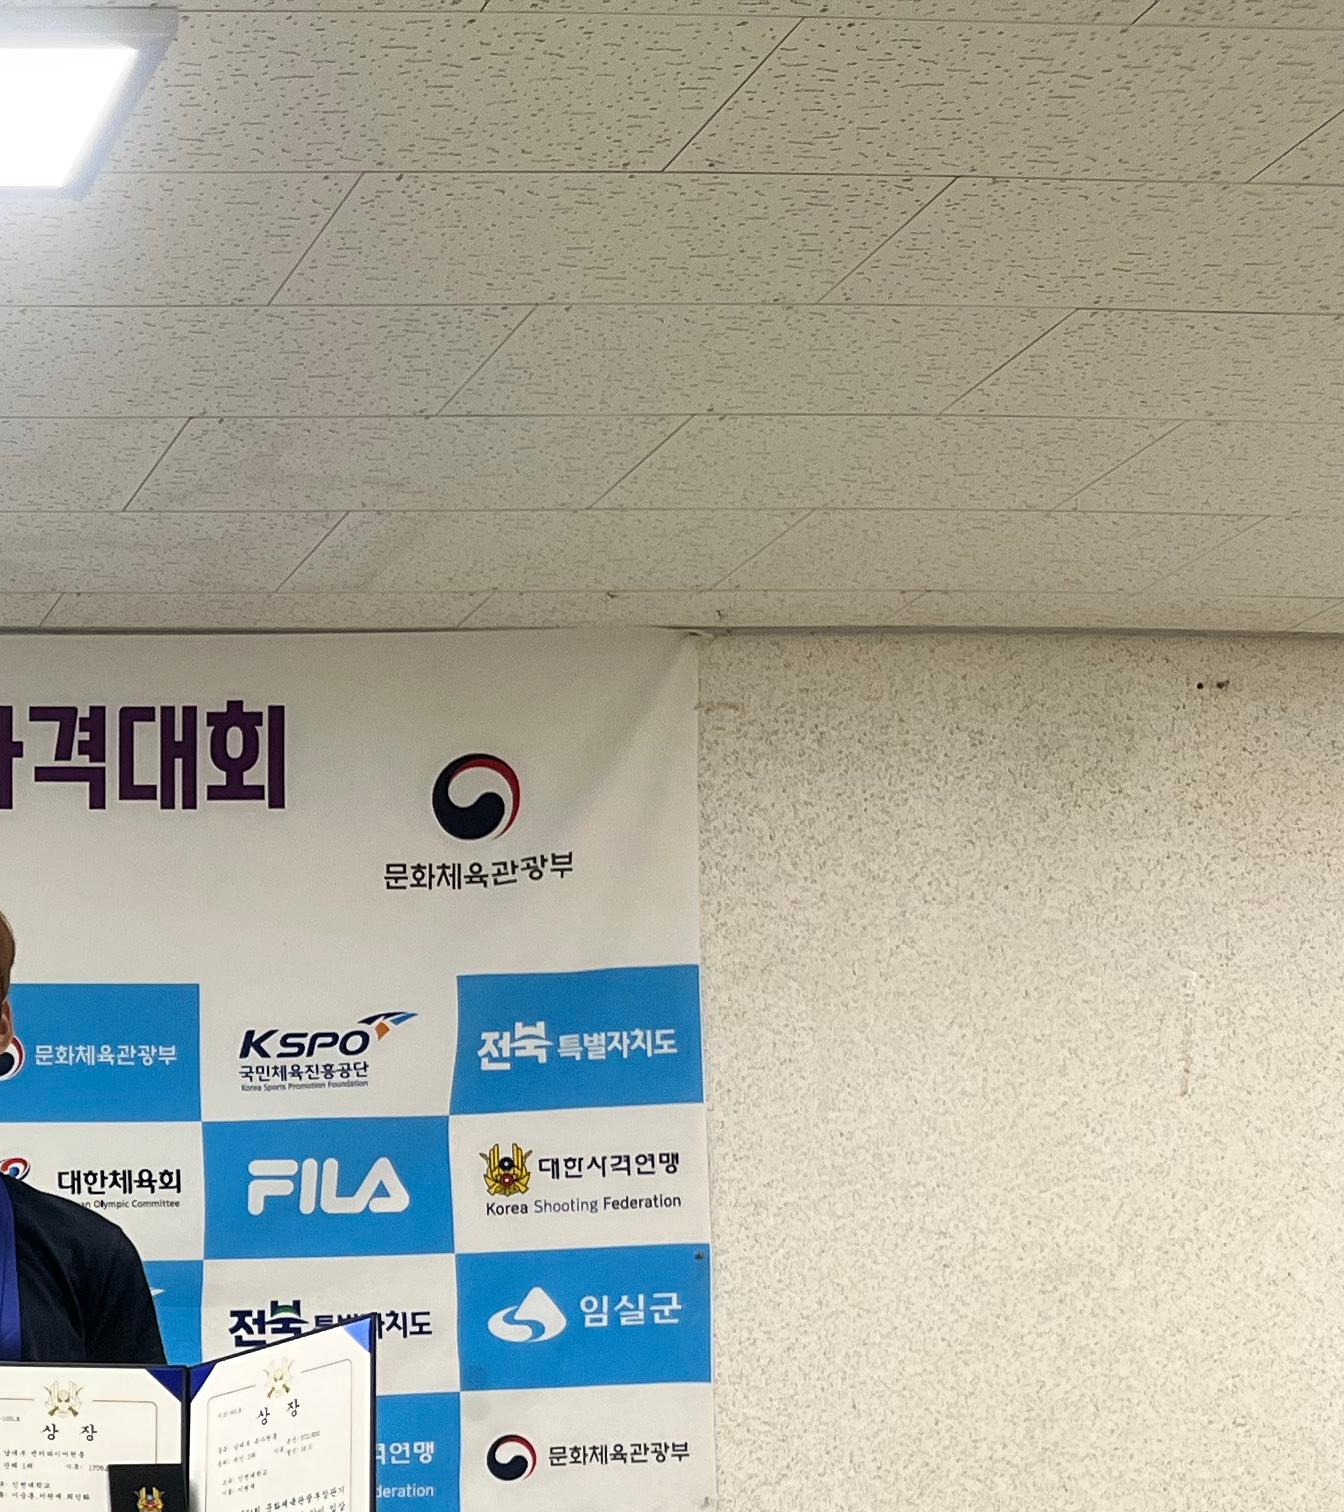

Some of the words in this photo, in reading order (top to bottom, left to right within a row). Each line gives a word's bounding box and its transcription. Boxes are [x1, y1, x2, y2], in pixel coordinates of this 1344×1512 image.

[384, 851, 574, 890] 문화체육관광부
[34, 1045, 177, 1066] 문화체육관광부
[239, 1029, 369, 1059] KSPO
[557, 1028, 679, 1062] 특별자치도
[239, 1062, 369, 1082] 국민체육진흥공단
[241, 1083, 262, 1091] Korea
[264, 1083, 286, 1091] Sports
[288, 1082, 325, 1091] Promotion
[328, 1081, 369, 1090] Foundation
[538, 1151, 680, 1181] 대한사격연맹
[58, 1169, 181, 1194] 대한체육회
[248, 1156, 409, 1215] FILA
[94, 1199, 130, 1209] Olympic
[132, 1199, 180, 1208] Committee
[486, 1200, 528, 1216] Korea
[533, 1196, 599, 1217] Shooting
[603, 1193, 682, 1212] Federation
[579, 1293, 682, 1326] 임실군
[548, 1441, 690, 1467] 문화체육관광부
[375, 1483, 434, 1498] deration
